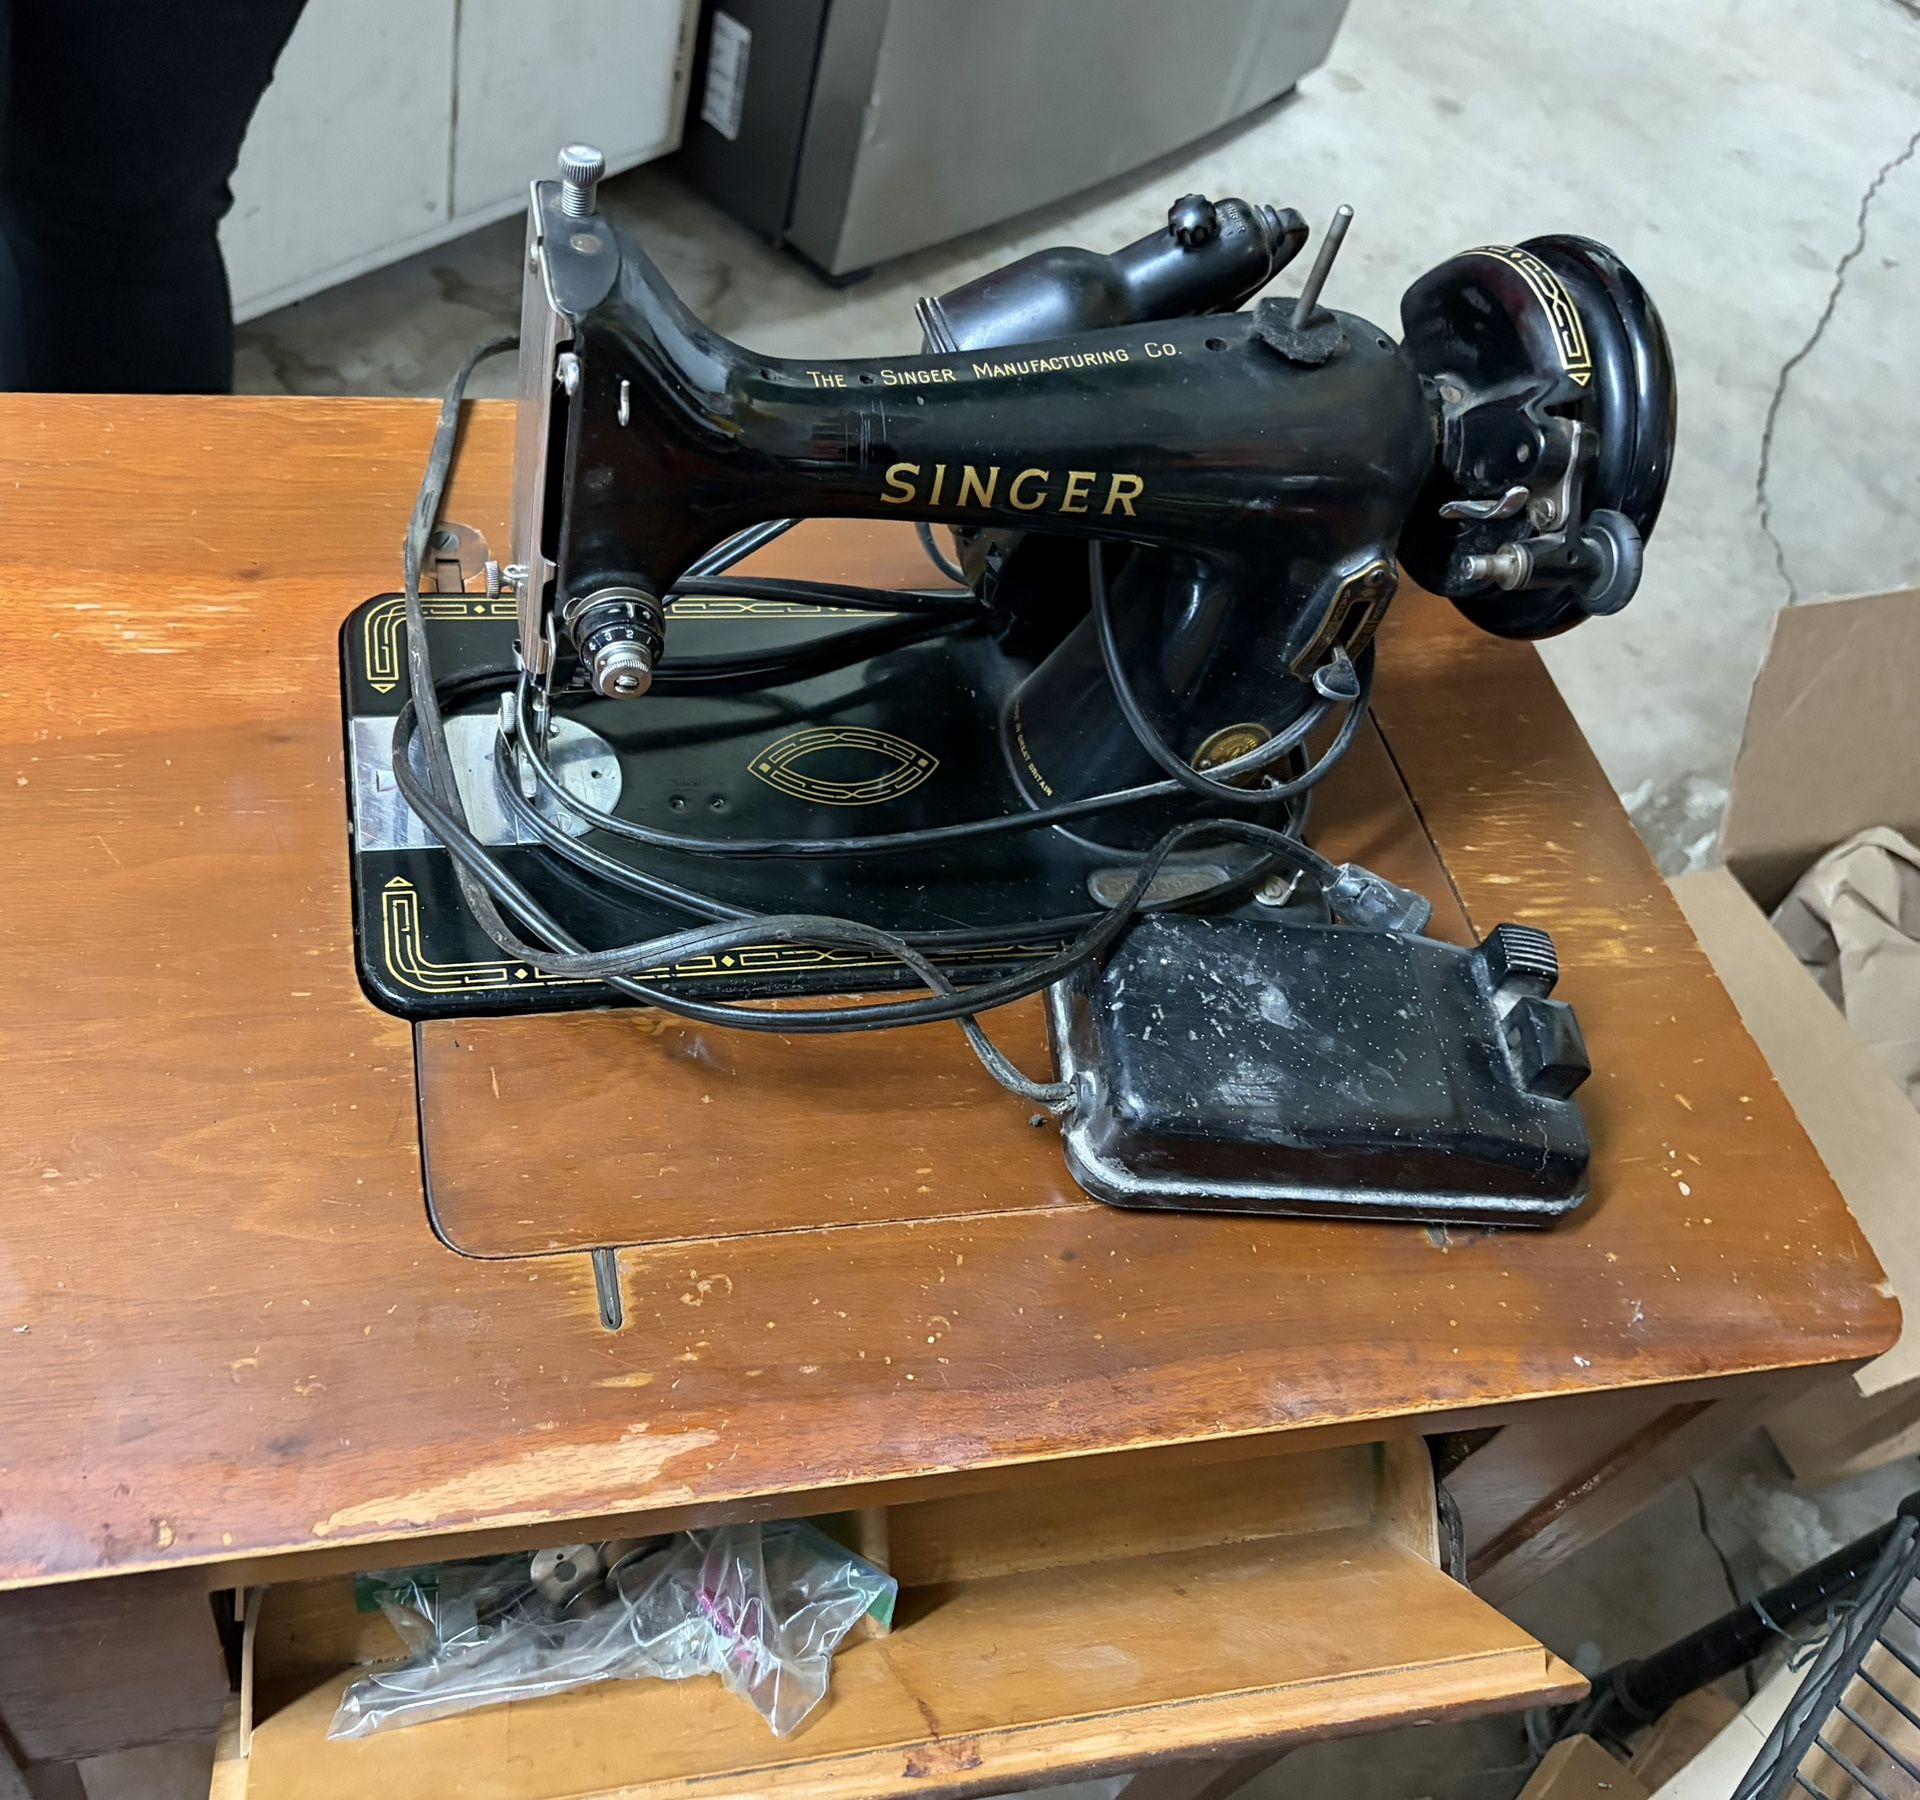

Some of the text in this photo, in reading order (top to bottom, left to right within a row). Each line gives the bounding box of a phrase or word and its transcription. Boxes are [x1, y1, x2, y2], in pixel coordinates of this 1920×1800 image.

[880, 368, 957, 387] SINGER
[972, 347, 1130, 380] MANUFACTURING
[880, 462, 1145, 518] SINGER
[604, 632, 613, 642] 3
[625, 628, 634, 639] 2
[1028, 762, 1053, 797] BRITAIN
